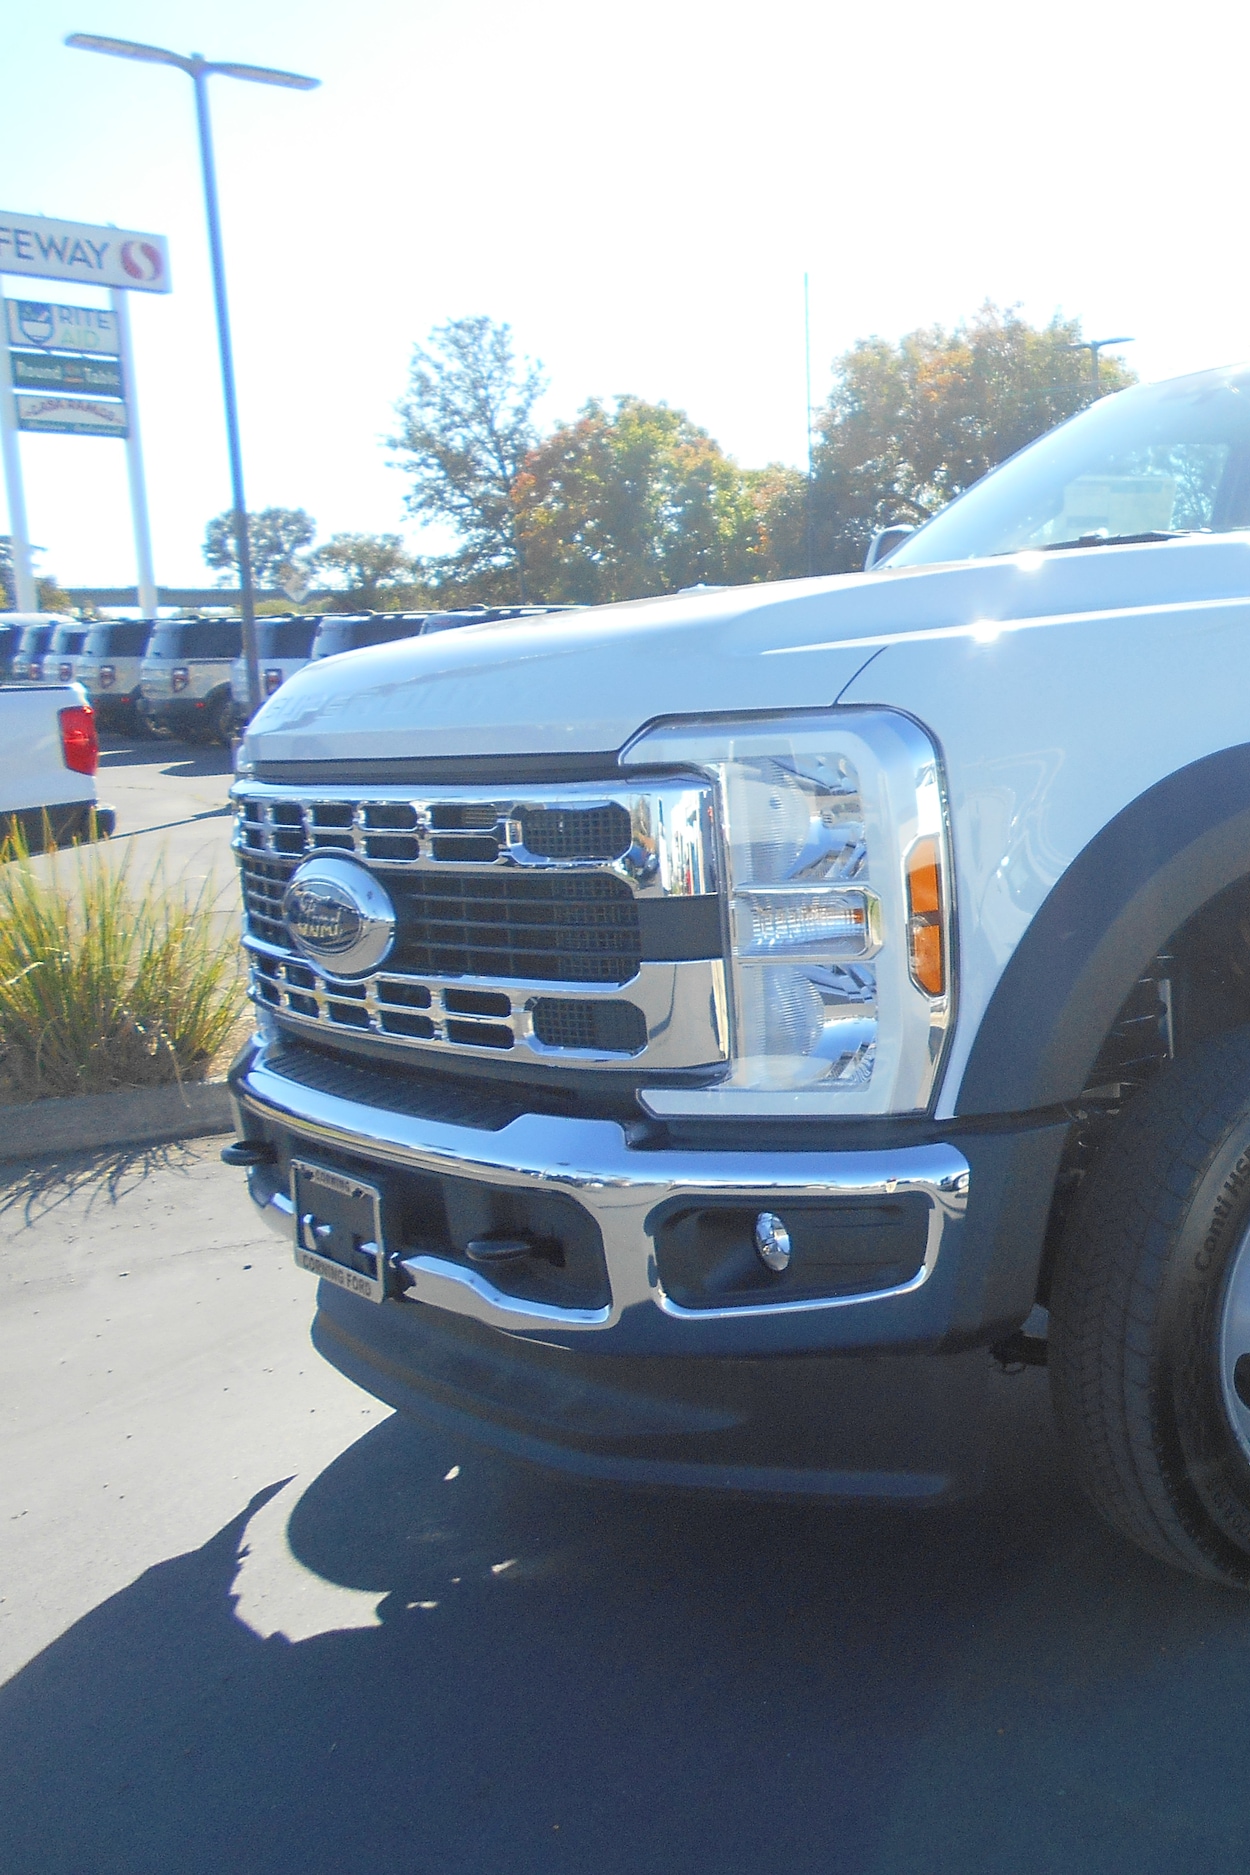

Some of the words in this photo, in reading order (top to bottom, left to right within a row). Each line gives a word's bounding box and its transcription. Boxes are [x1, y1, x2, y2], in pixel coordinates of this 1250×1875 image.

[58, 306, 111, 330] RITE
[60, 330, 100, 350] AID
[1194, 1195, 1233, 1271] Conti
[346, 1270, 372, 1297] FORD
